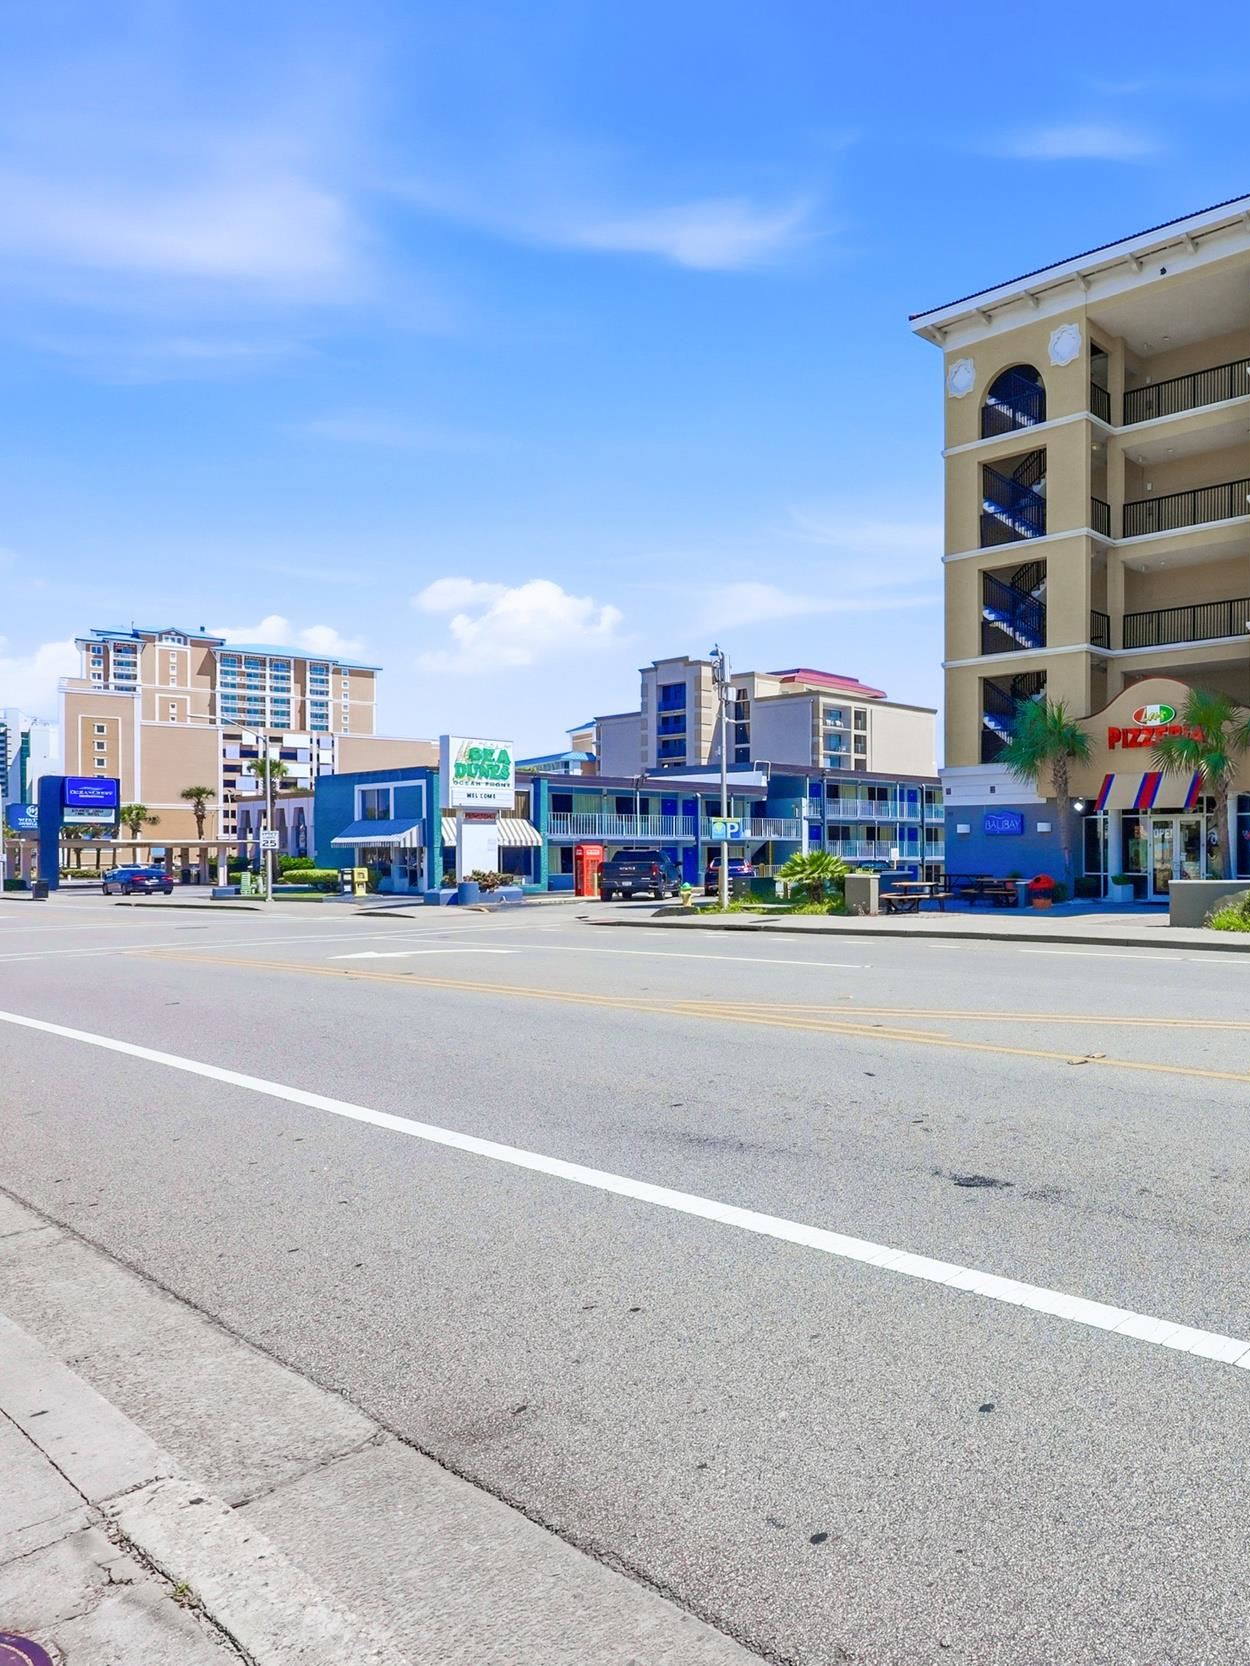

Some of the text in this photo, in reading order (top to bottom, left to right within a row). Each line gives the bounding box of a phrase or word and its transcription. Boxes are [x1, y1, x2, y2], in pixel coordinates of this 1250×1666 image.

[468, 747, 511, 765] SEA
[454, 762, 510, 780] DUNES
[262, 839, 277, 847] 25
